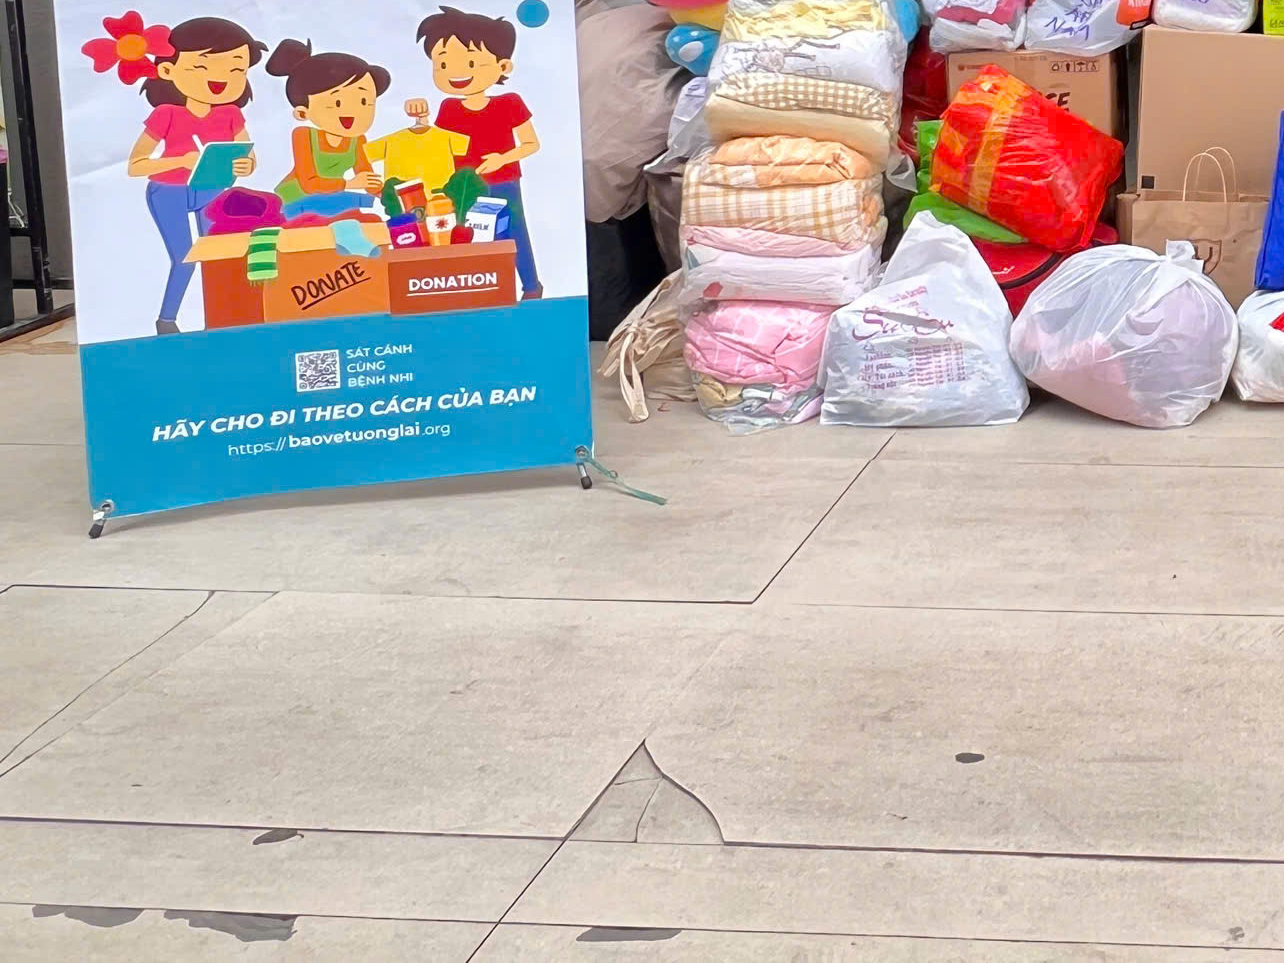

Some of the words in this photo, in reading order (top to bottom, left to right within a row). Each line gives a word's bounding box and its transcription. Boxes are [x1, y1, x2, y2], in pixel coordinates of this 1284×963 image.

[291, 260, 365, 306] DONATE
[408, 271, 498, 292] DONATION
[389, 372, 414, 383] NHI
[153, 419, 207, 442] HÃY
[211, 413, 264, 433] CHO
[269, 409, 296, 427] ĐI
[302, 402, 364, 423] THEO
[369, 394, 433, 416] CÁCH
[437, 387, 484, 410] CỦA
[489, 386, 537, 407] BẠN
